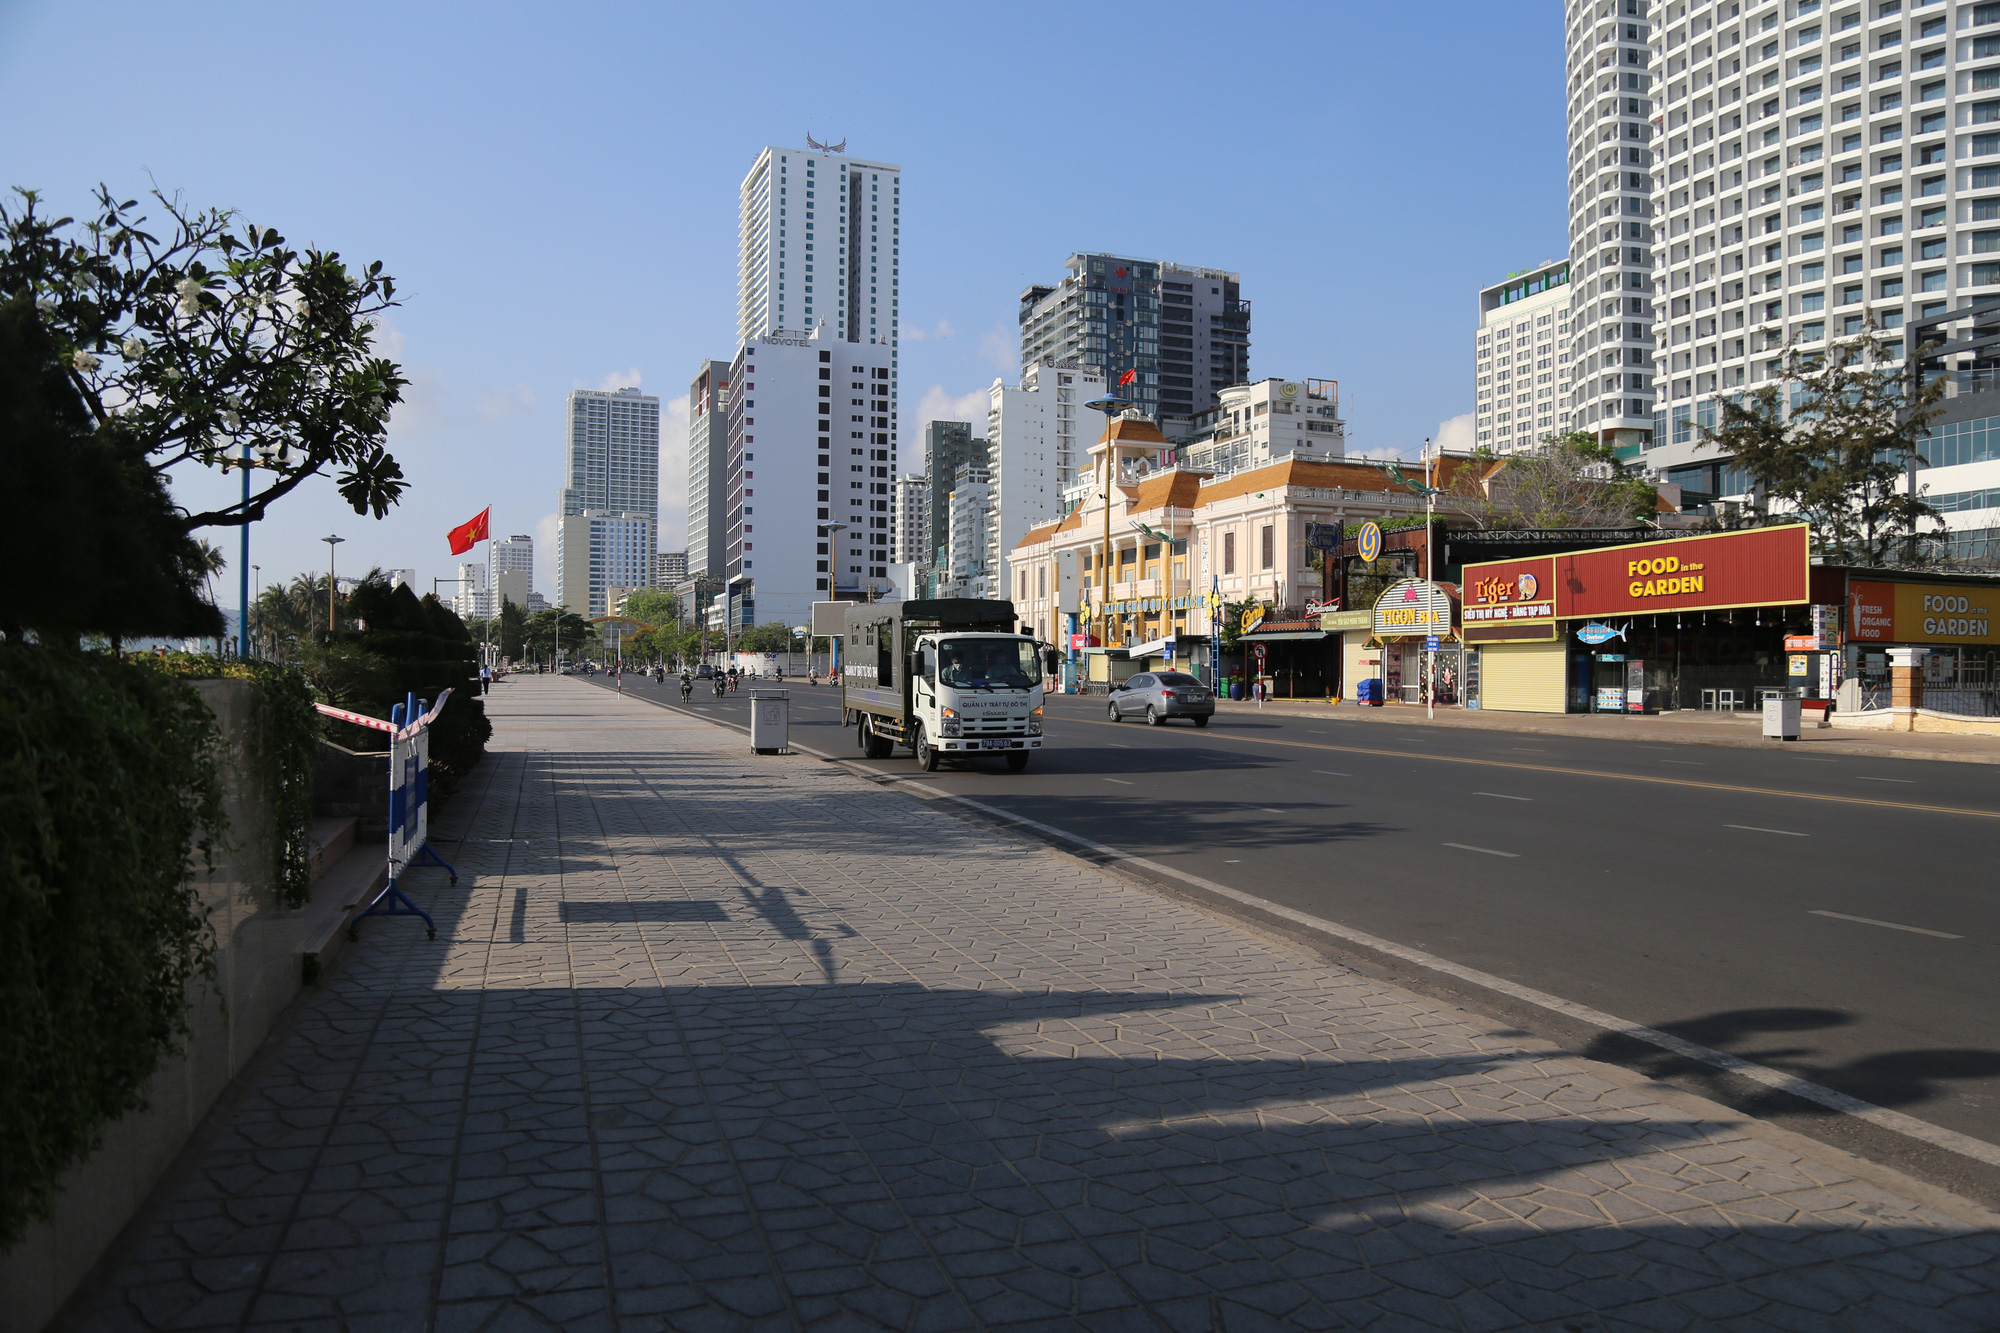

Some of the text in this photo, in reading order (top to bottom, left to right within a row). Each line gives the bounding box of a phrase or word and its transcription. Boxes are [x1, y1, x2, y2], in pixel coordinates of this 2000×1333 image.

[762, 336, 811, 348] NOVOTEL
[1628, 556, 1680, 577] FOOD
[1690, 563, 1704, 571] the
[1475, 577, 1515, 604] Tiger
[1629, 576, 1704, 597] GARDEN
[1513, 605, 1527, 617] HÀNG
[1528, 606, 1538, 618] TẠP
[1539, 603, 1551, 615] HÓA
[1861, 605, 1882, 614] FRESH
[1923, 595, 1969, 613] FOOD
[1381, 608, 1416, 625] TIGON
[1861, 617, 1891, 627] ORGANIC
[1861, 629, 1880, 638] FOOD
[1923, 617, 1988, 636] GARDEN
